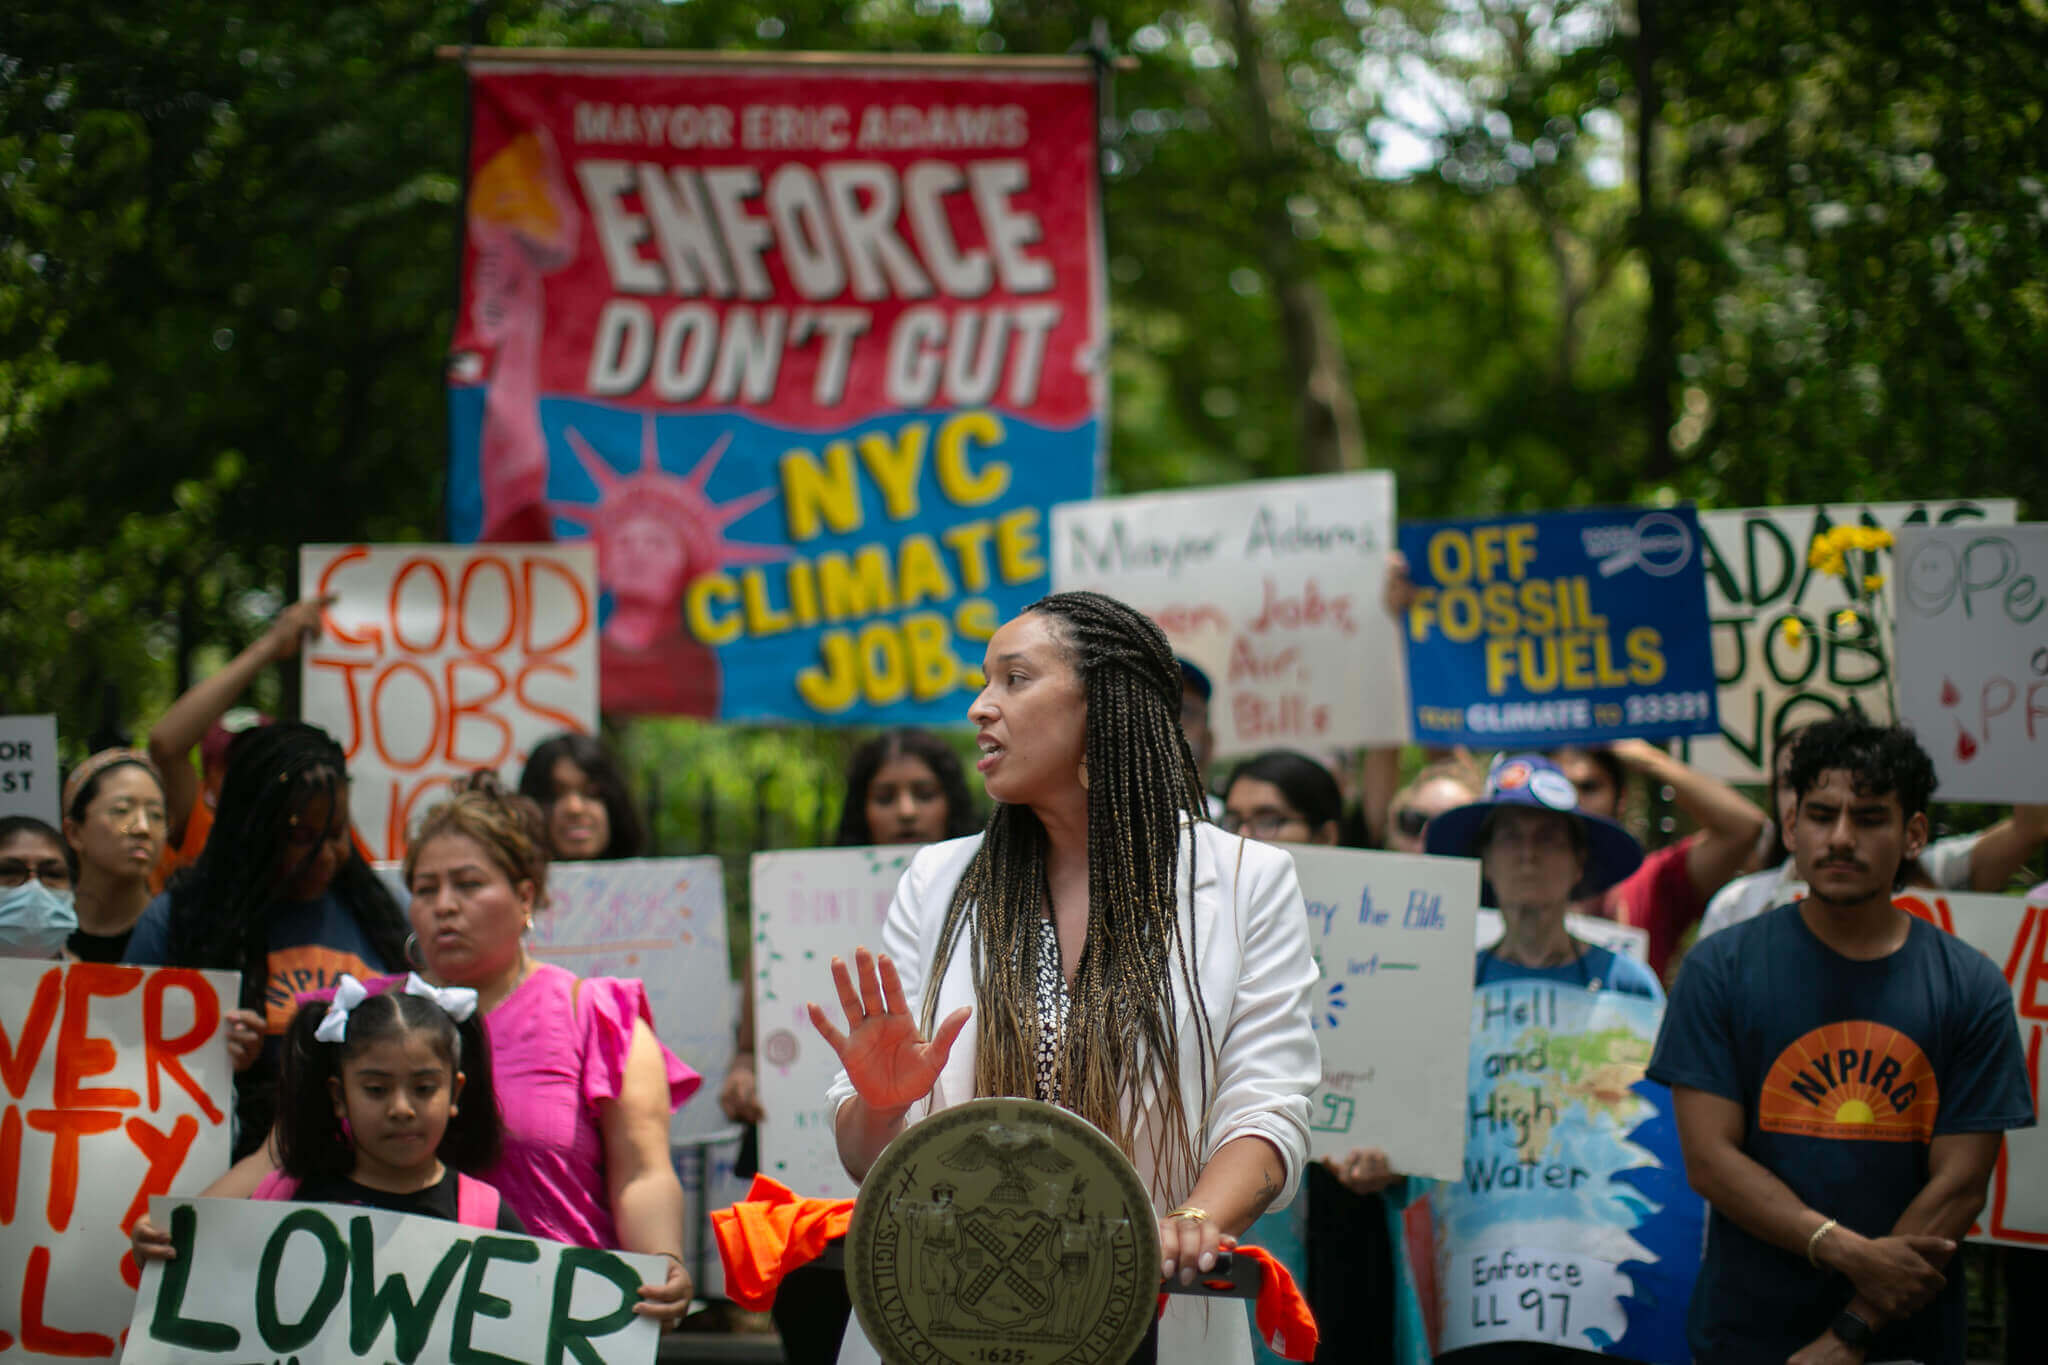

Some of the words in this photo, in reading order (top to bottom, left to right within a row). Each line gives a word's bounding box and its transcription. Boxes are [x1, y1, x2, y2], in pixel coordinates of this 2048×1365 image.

[574, 102, 733, 145] MAYOR
[741, 106, 851, 150] ERIC
[857, 105, 1031, 150] ADAMS
[575, 160, 1056, 300] ENFORCE
[587, 302, 872, 407] DON'T
[885, 305, 1062, 408] GUT
[779, 411, 1010, 541] NYC
[1070, 517, 1225, 580] Mayor
[1245, 498, 1378, 560] Adams
[1428, 523, 1540, 586] OFF
[316, 546, 591, 657] GOOD
[685, 508, 1045, 645] CLIMATE
[1409, 575, 1609, 643] FOSSIL
[796, 598, 996, 714] JOBS
[1486, 626, 1667, 697] FUELS
[1466, 698, 1592, 733] CLIMATE
[1482, 987, 1557, 1031] Hell
[1483, 1041, 1549, 1080] and
[1790, 1048, 1918, 1114] NYPIRG
[1469, 1088, 1558, 1149] High
[1464, 1152, 1591, 1195] Water
[150, 1204, 647, 1365] LOWER
[1472, 1250, 1584, 1289] Enforce
[1471, 1296, 1508, 1329] LL
[1519, 1287, 1571, 1338] 97
[978, 1348, 1025, 1364] 1625
